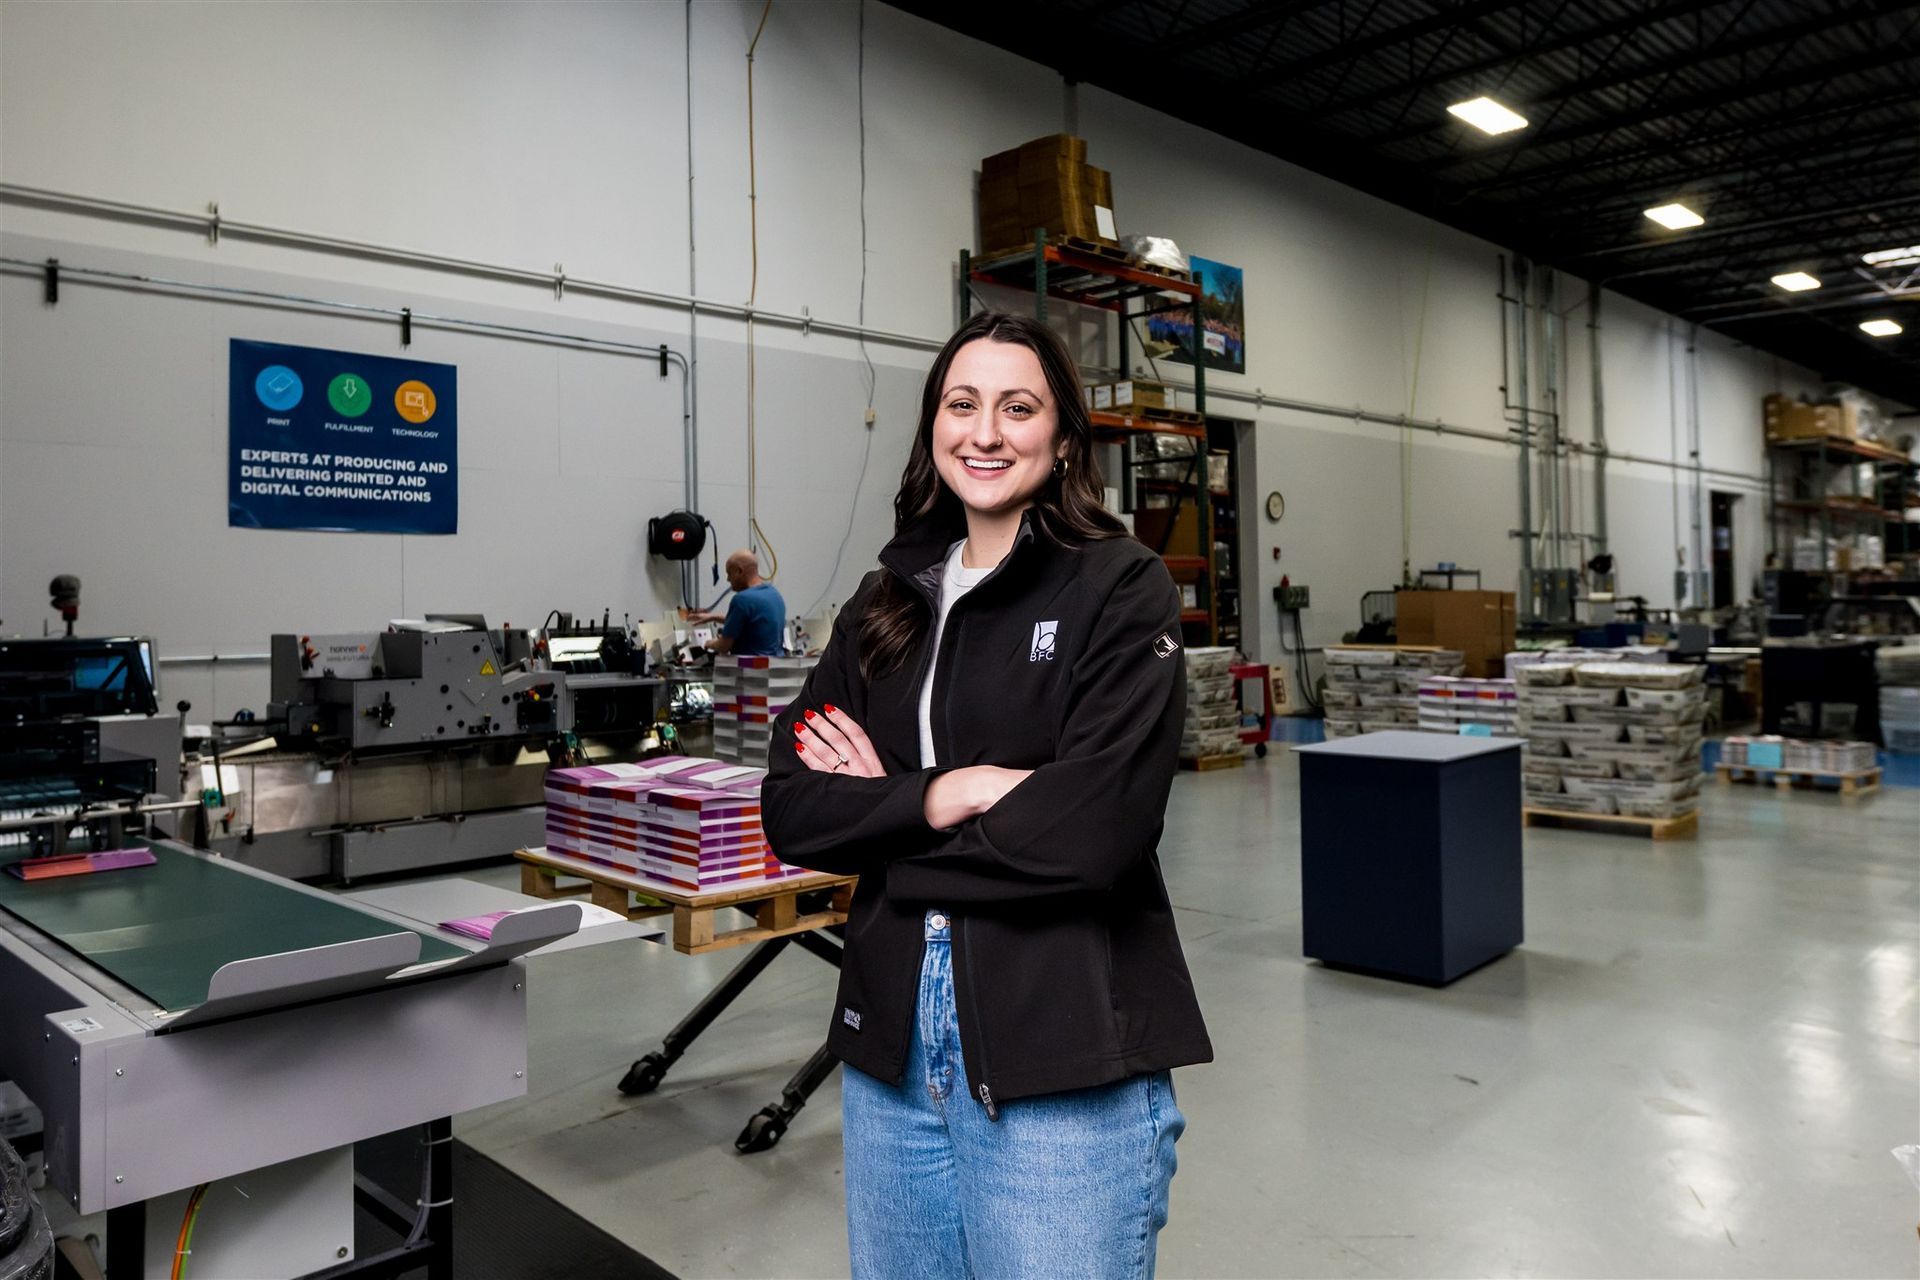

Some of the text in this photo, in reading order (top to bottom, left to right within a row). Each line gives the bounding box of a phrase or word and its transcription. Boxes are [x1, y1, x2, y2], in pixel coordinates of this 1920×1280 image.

[267, 417, 290, 426] PRINT
[325, 422, 374, 433] FULFILLMENT
[392, 428, 439, 439] TECHNOLOGY
[241, 449, 448, 474] EXPERTS AT PRODUCING AND
[241, 465, 427, 487] DELIVERING PRINTED AND
[241, 482, 432, 503] DIGITAL COMMUNICATIONS
[1030, 651, 1054, 661] BFC
